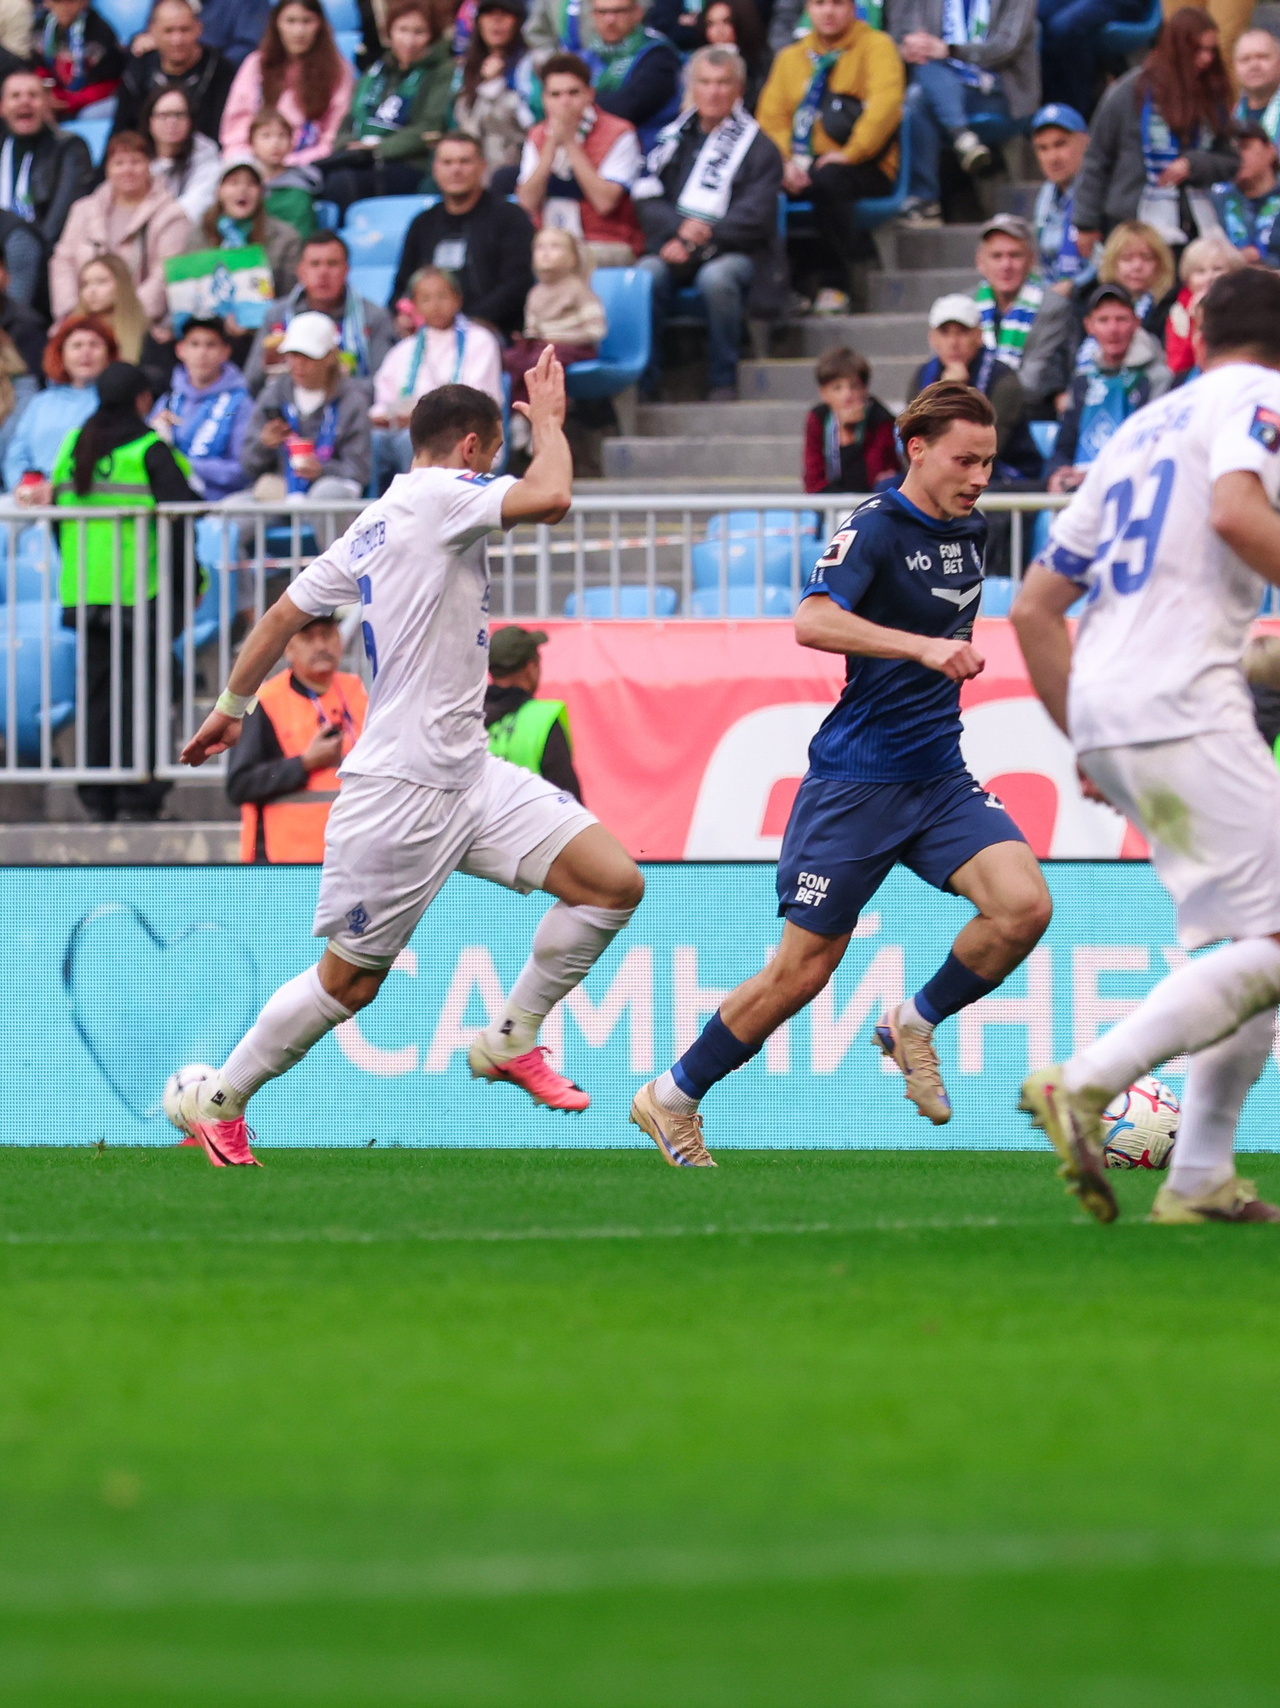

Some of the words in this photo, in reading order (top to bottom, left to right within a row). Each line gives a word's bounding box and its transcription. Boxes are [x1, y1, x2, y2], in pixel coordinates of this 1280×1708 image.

[939, 542, 962, 559] FON
[943, 558, 963, 575] BET
[797, 871, 831, 892] FON
[794, 886, 828, 907] BET
